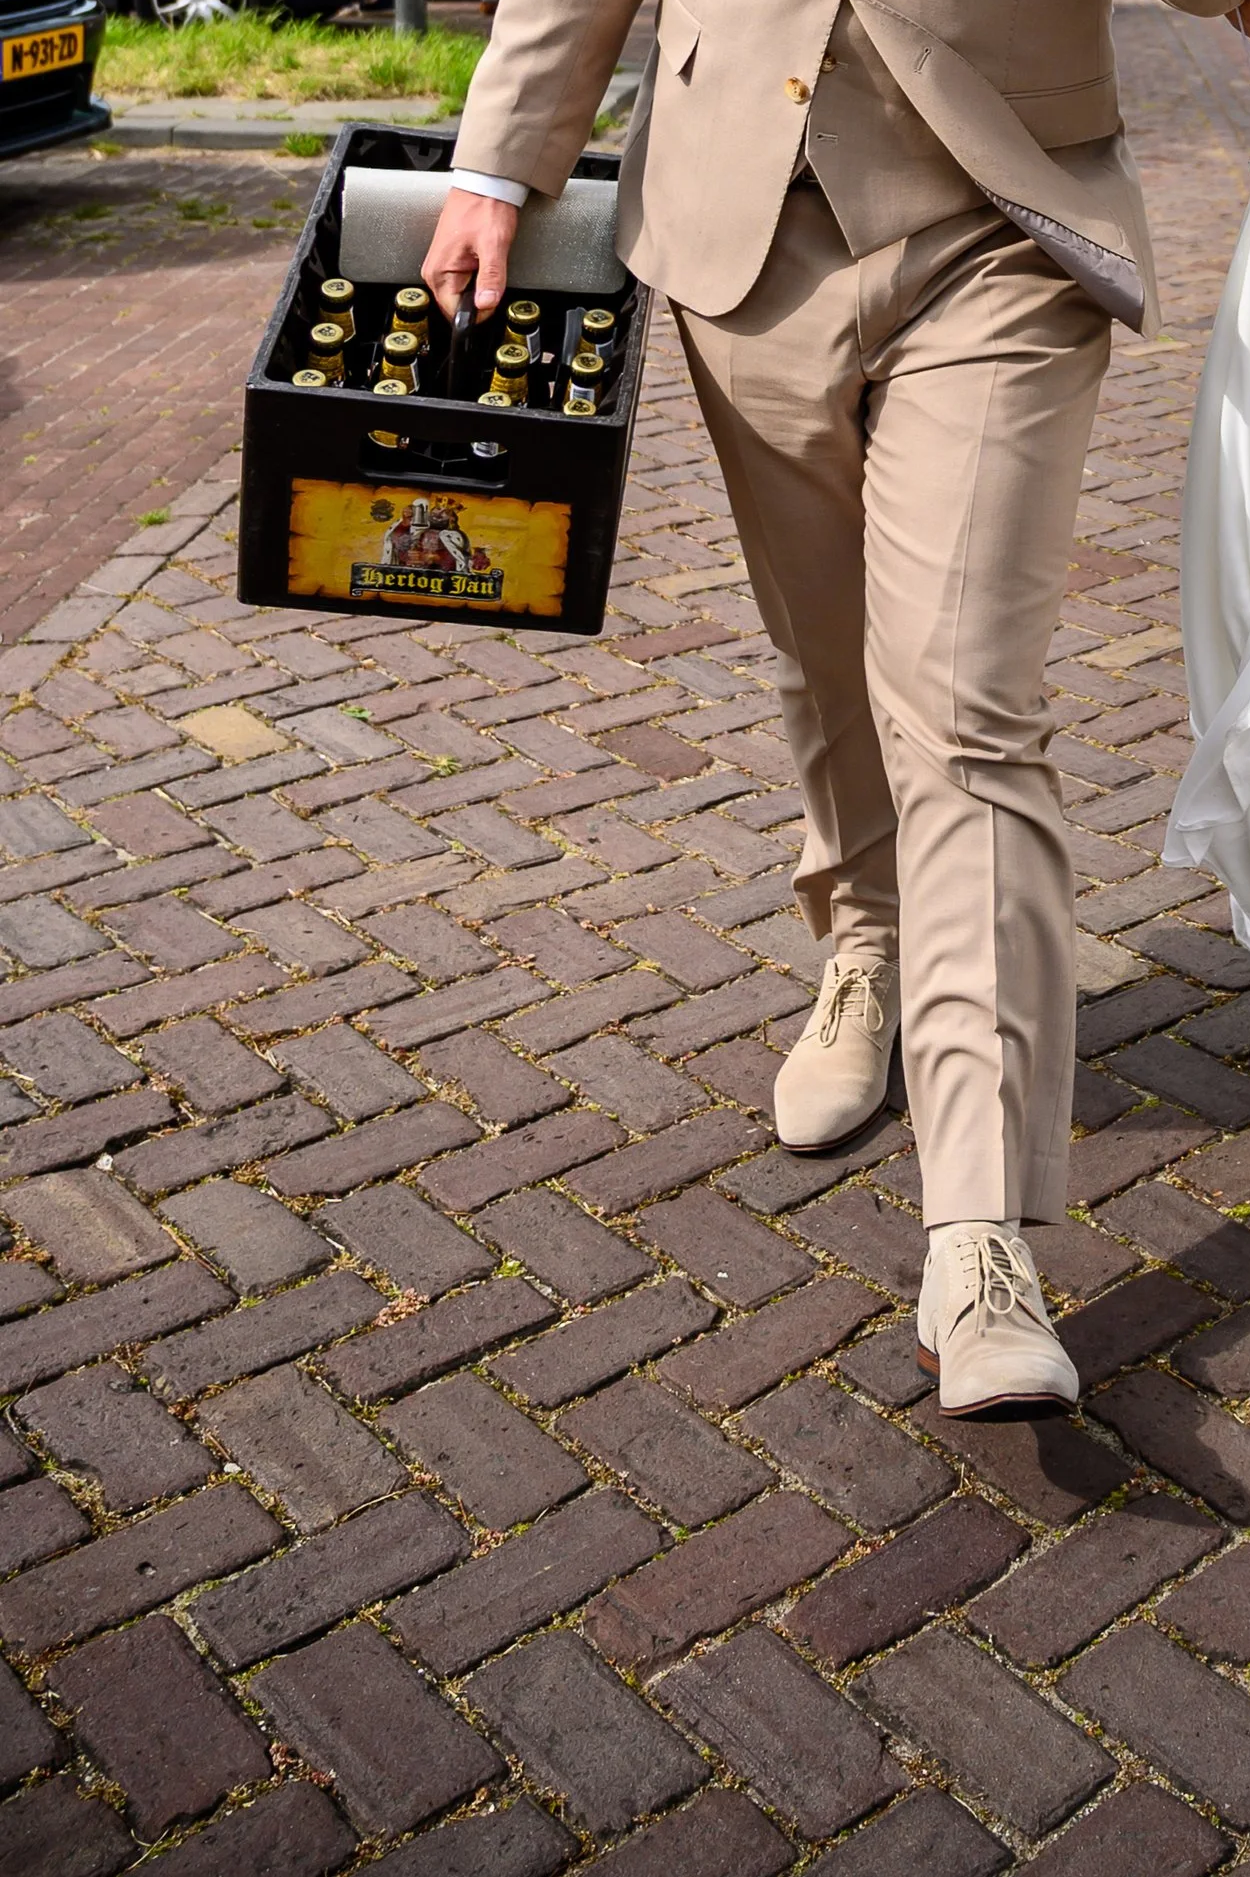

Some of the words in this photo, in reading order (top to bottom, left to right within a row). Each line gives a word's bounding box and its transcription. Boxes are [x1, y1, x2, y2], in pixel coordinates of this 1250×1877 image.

[11, 32, 79, 73] N-931-ZD
[361, 567, 444, 593] Hertog
[449, 575, 495, 595] Jan
